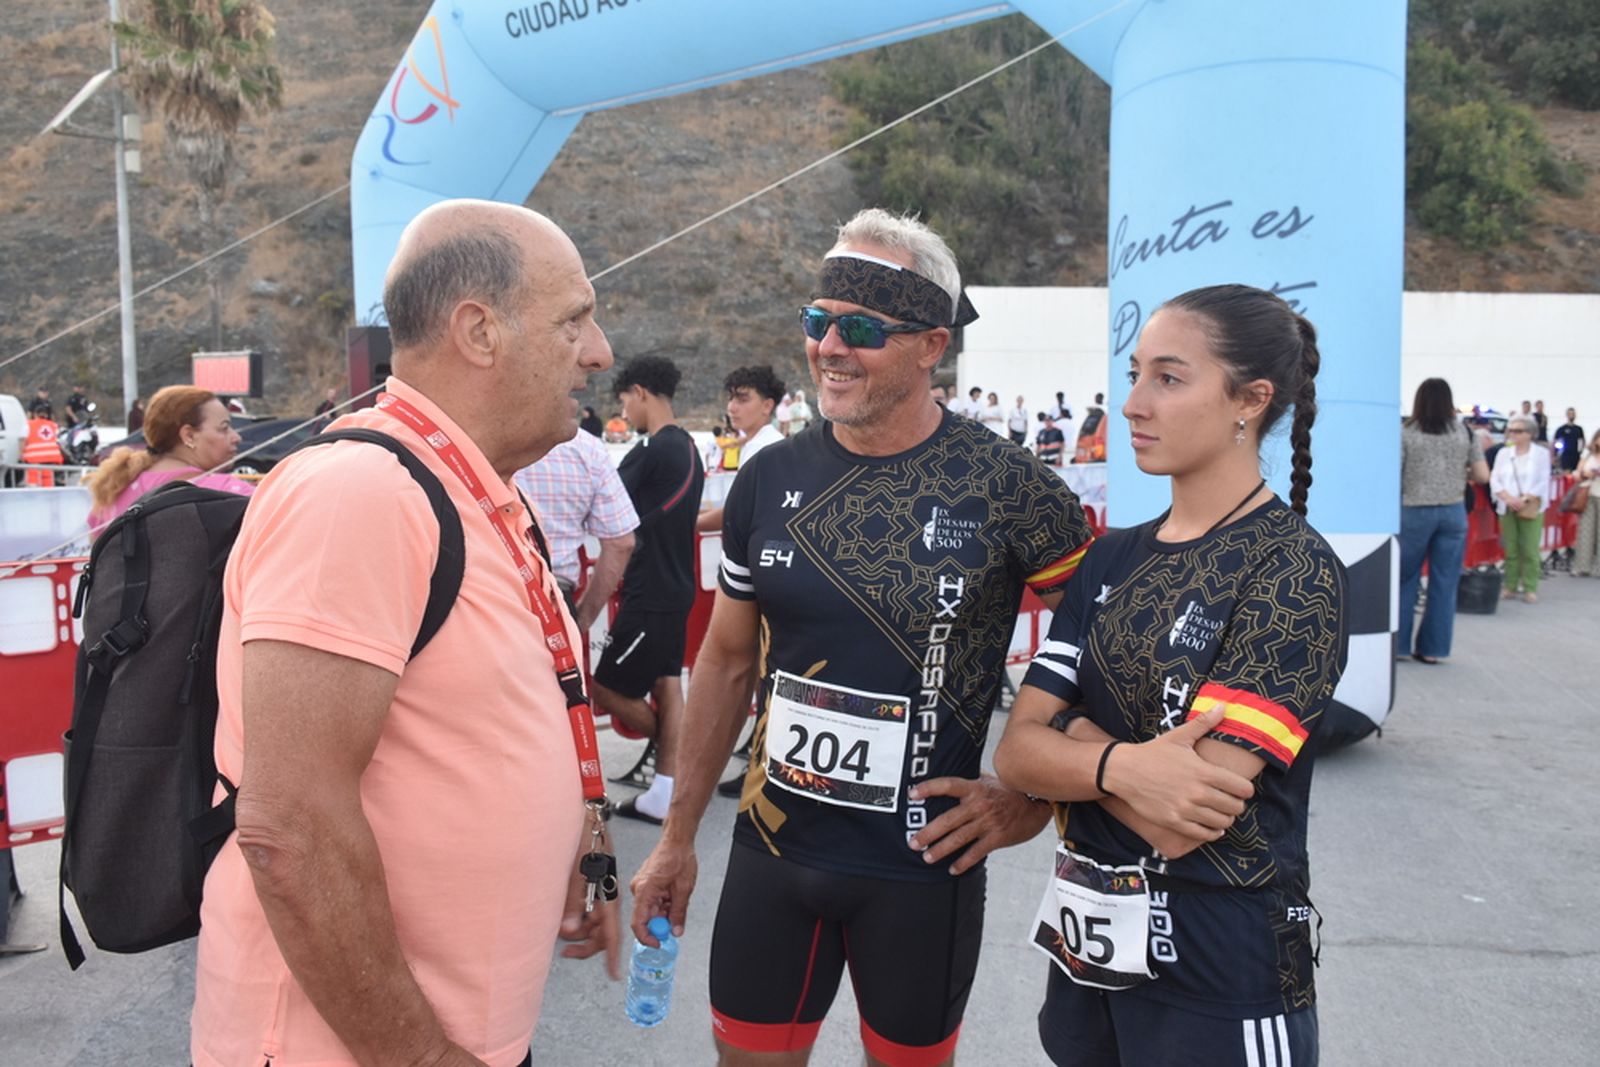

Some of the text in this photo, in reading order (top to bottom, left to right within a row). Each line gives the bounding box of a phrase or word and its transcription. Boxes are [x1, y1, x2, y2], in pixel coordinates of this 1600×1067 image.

[504, 0, 590, 38] CIUDAD
[1110, 200, 1314, 280] Ceuta es
[759, 549, 794, 568] 54
[953, 530, 972, 539] LOS
[910, 624, 953, 778] DESAFIO
[784, 723, 871, 781] 204
[1060, 905, 1115, 965] 05
